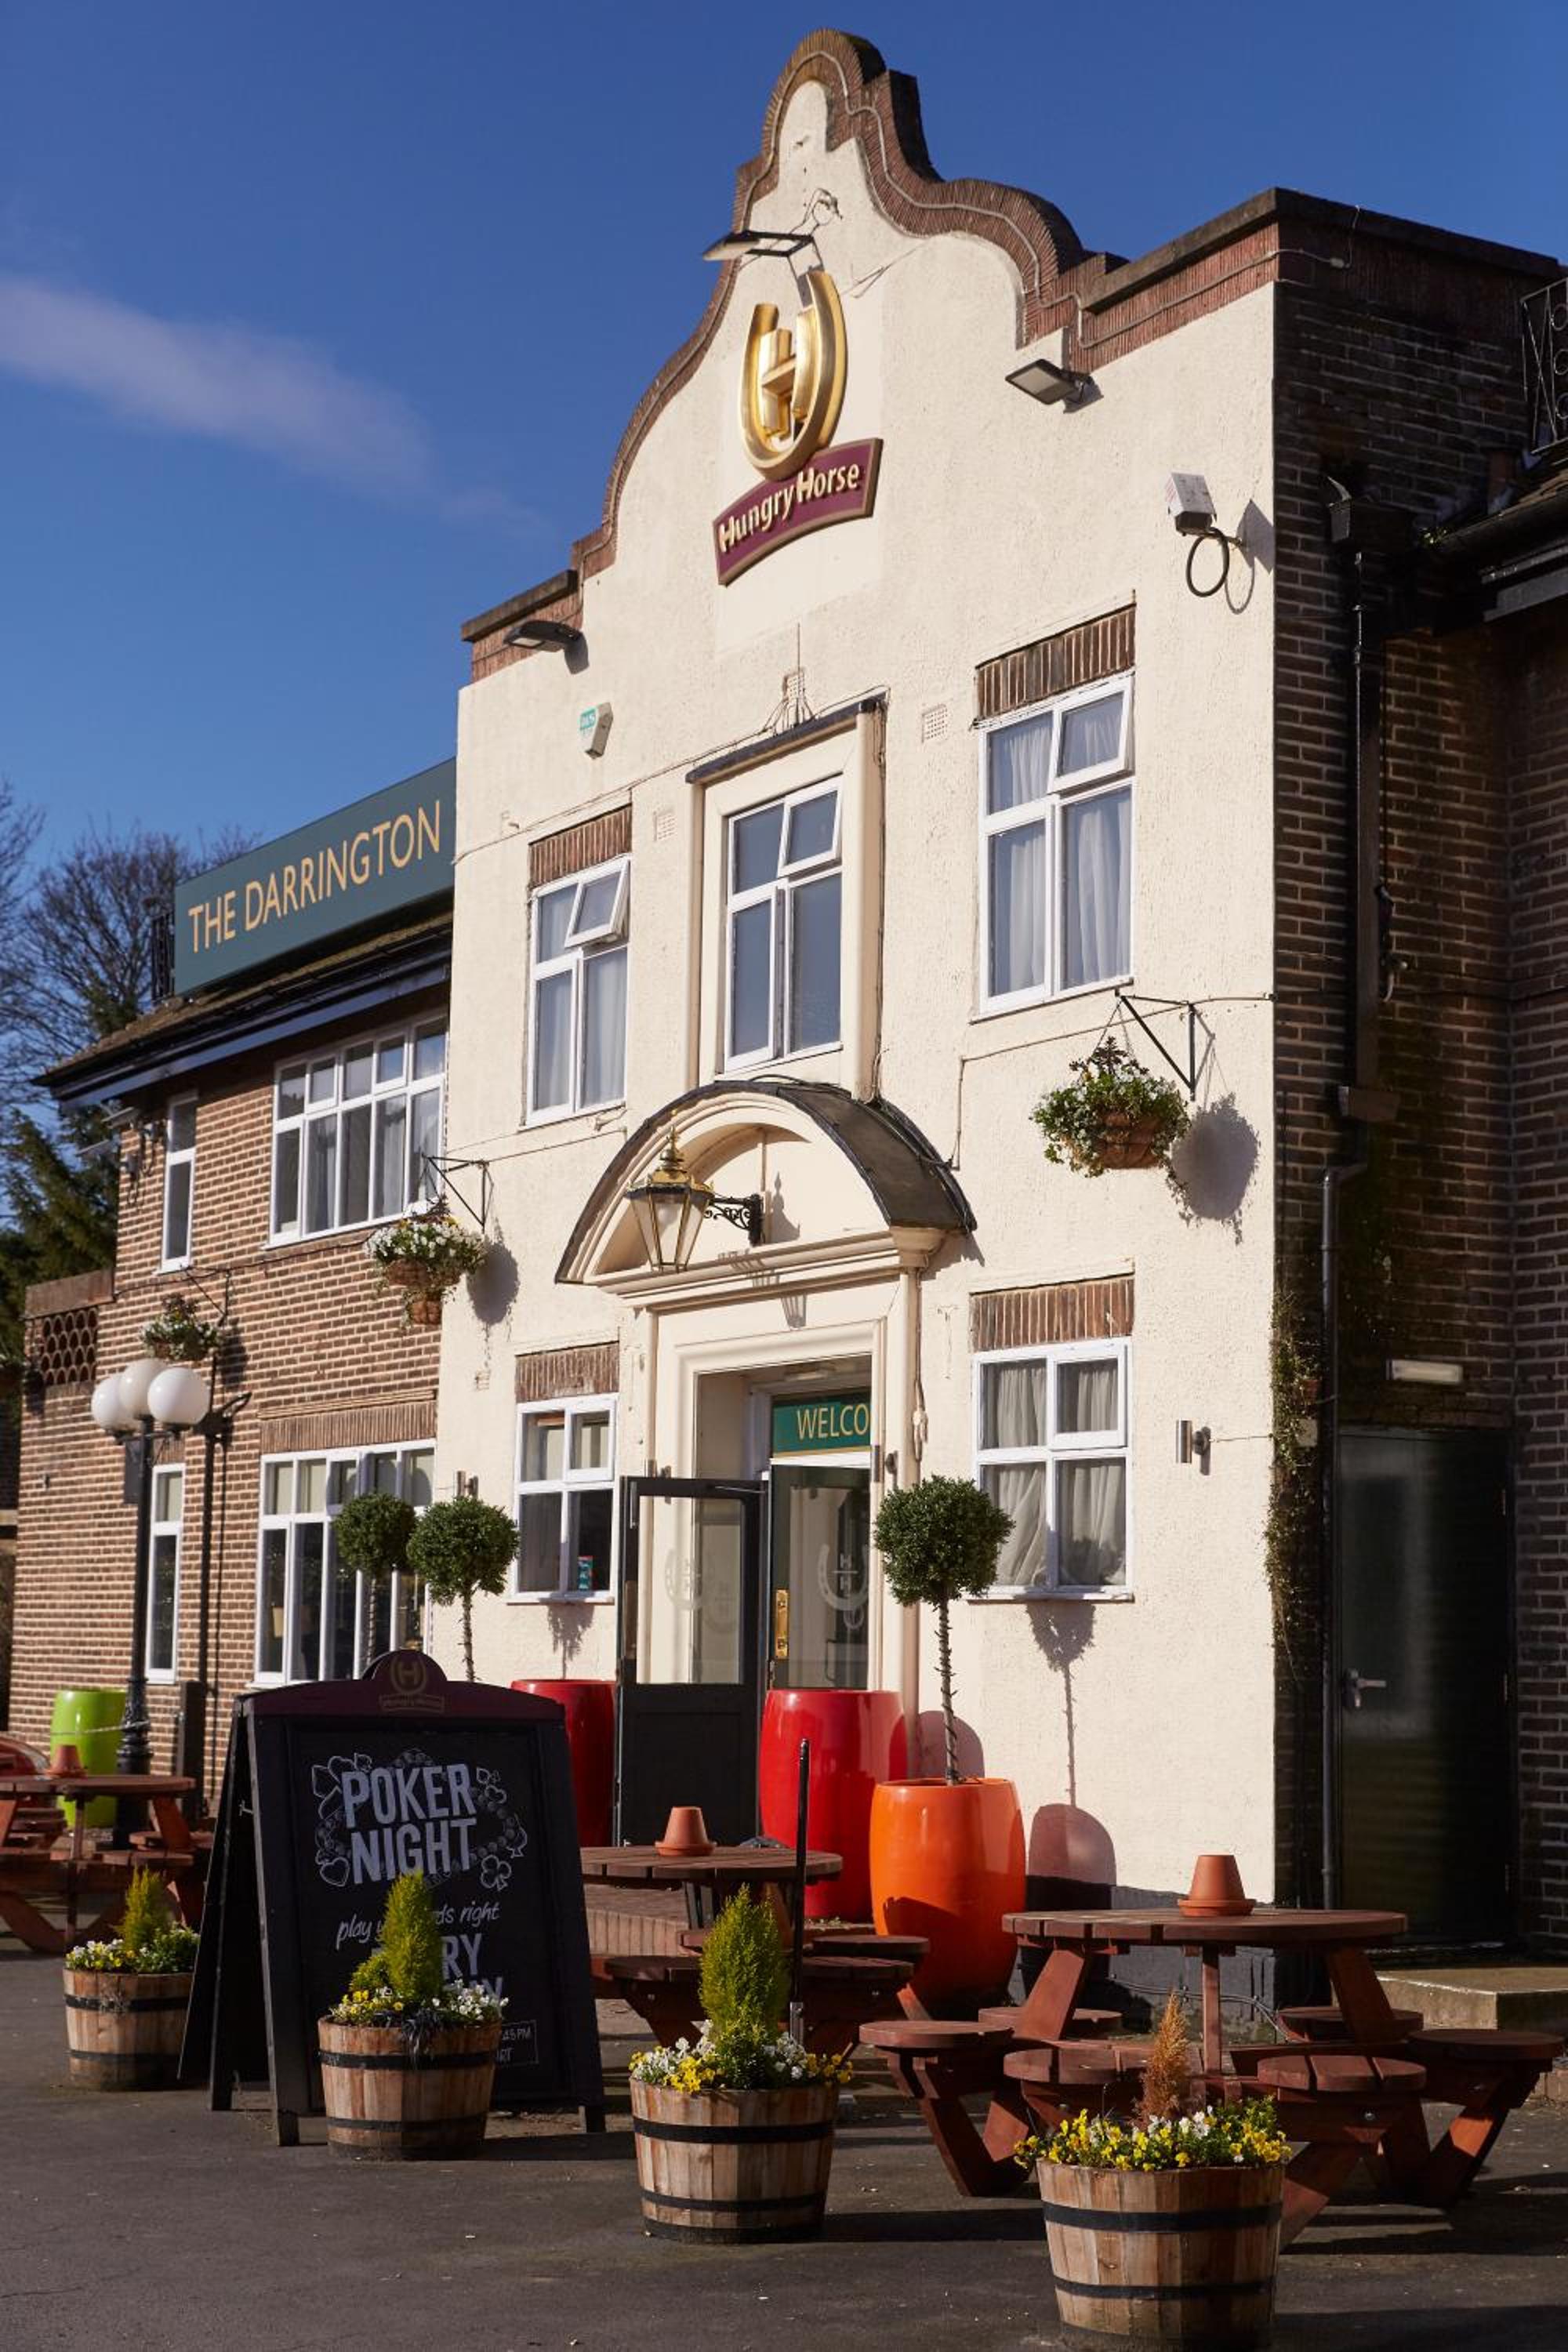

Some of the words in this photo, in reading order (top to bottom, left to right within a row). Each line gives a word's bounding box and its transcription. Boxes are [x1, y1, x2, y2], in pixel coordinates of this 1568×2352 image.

[719, 485, 795, 552] Hungry
[796, 463, 859, 503] Horse
[188, 890, 238, 954] THE
[245, 800, 441, 932] DARRINGTON
[797, 1403, 869, 1441] WELCO
[340, 1763, 477, 1829] POKER
[350, 1817, 477, 1884] NIGHT
[336, 1914, 372, 1951] play
[460, 1900, 501, 1927] right
